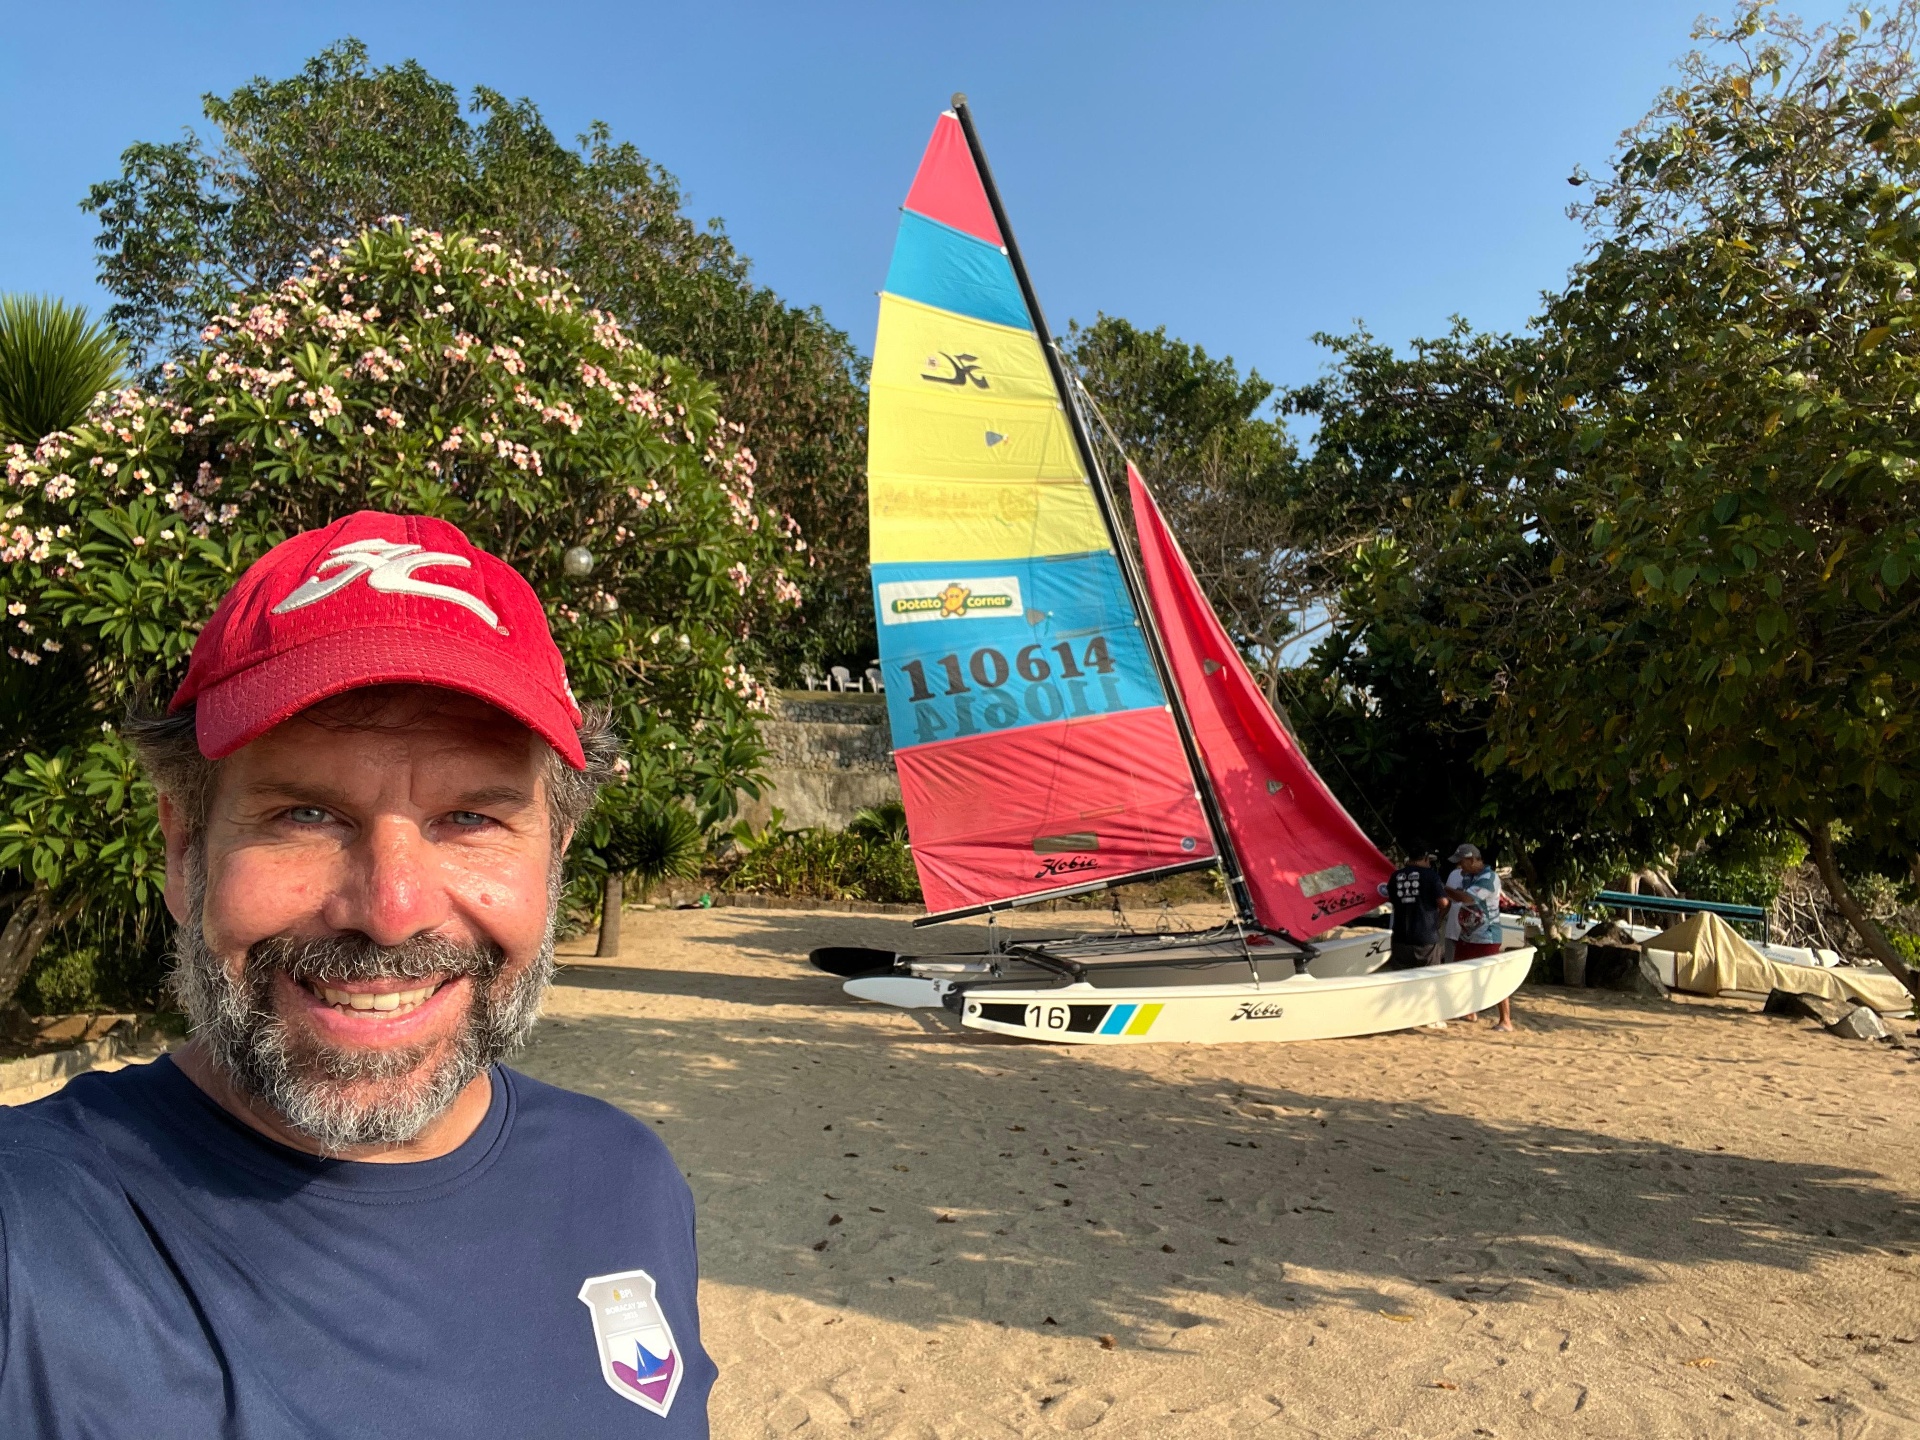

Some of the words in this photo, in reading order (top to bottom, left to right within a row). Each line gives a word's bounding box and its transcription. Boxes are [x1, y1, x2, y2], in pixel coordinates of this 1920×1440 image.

[901, 636, 1116, 702] 110614
[1034, 855, 1099, 879] Hobie
[1311, 890, 1366, 921] Hobie
[1029, 1005, 1065, 1029] 16
[1229, 1001, 1284, 1021] Hobie
